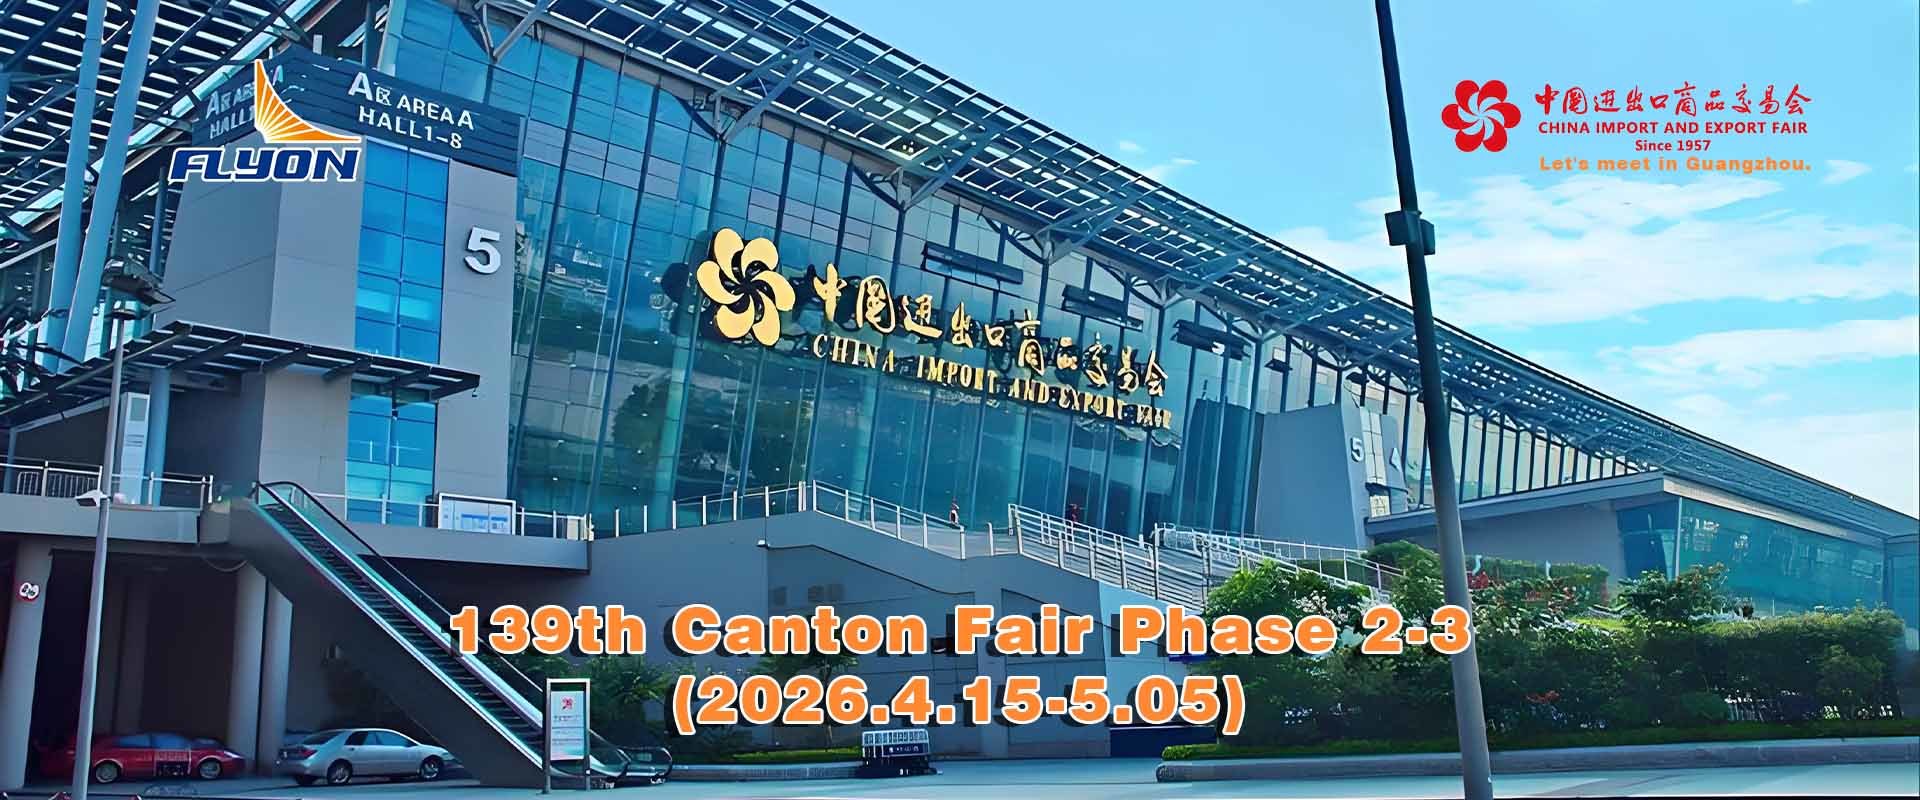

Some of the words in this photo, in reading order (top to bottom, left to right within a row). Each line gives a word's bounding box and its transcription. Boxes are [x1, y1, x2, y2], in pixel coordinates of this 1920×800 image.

[396, 94, 455, 125] AREA
[457, 110, 475, 131] A
[464, 226, 501, 274] 5
[813, 333, 895, 373] CHINA
[917, 355, 999, 394] IMPORT
[1008, 377, 1050, 404] AND
[1351, 437, 1364, 462] 5
